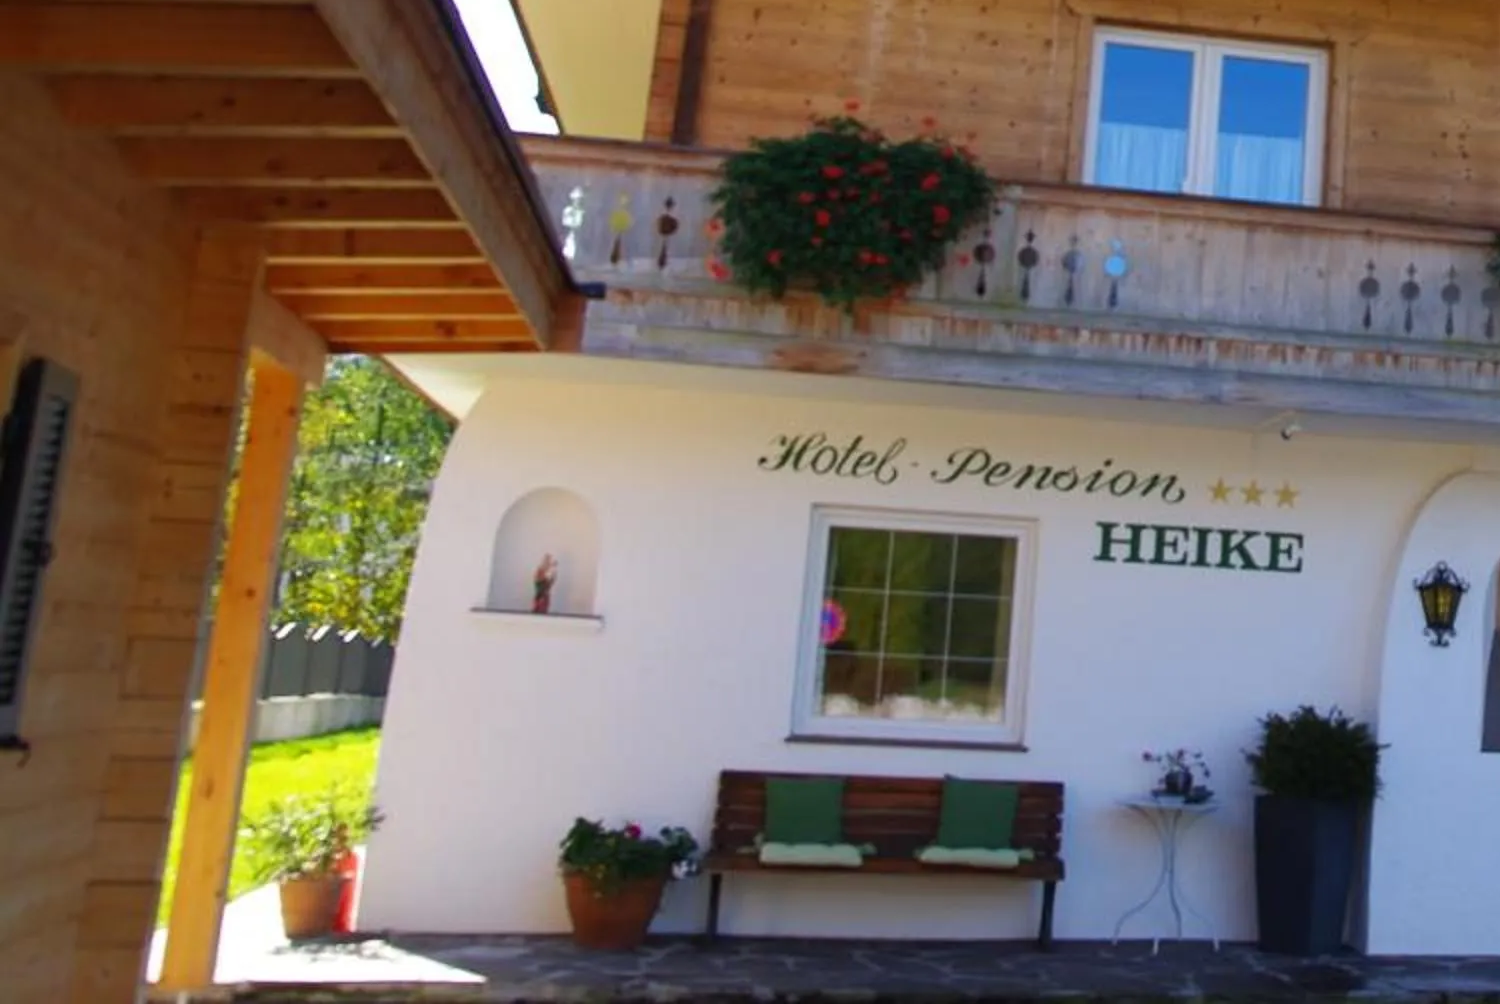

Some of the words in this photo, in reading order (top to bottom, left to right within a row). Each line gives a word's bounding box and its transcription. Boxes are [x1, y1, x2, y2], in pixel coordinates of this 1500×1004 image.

[758, 432, 906, 485] Hotel
[930, 446, 1186, 504] Pension
[1092, 521, 1304, 573] HEIKE
